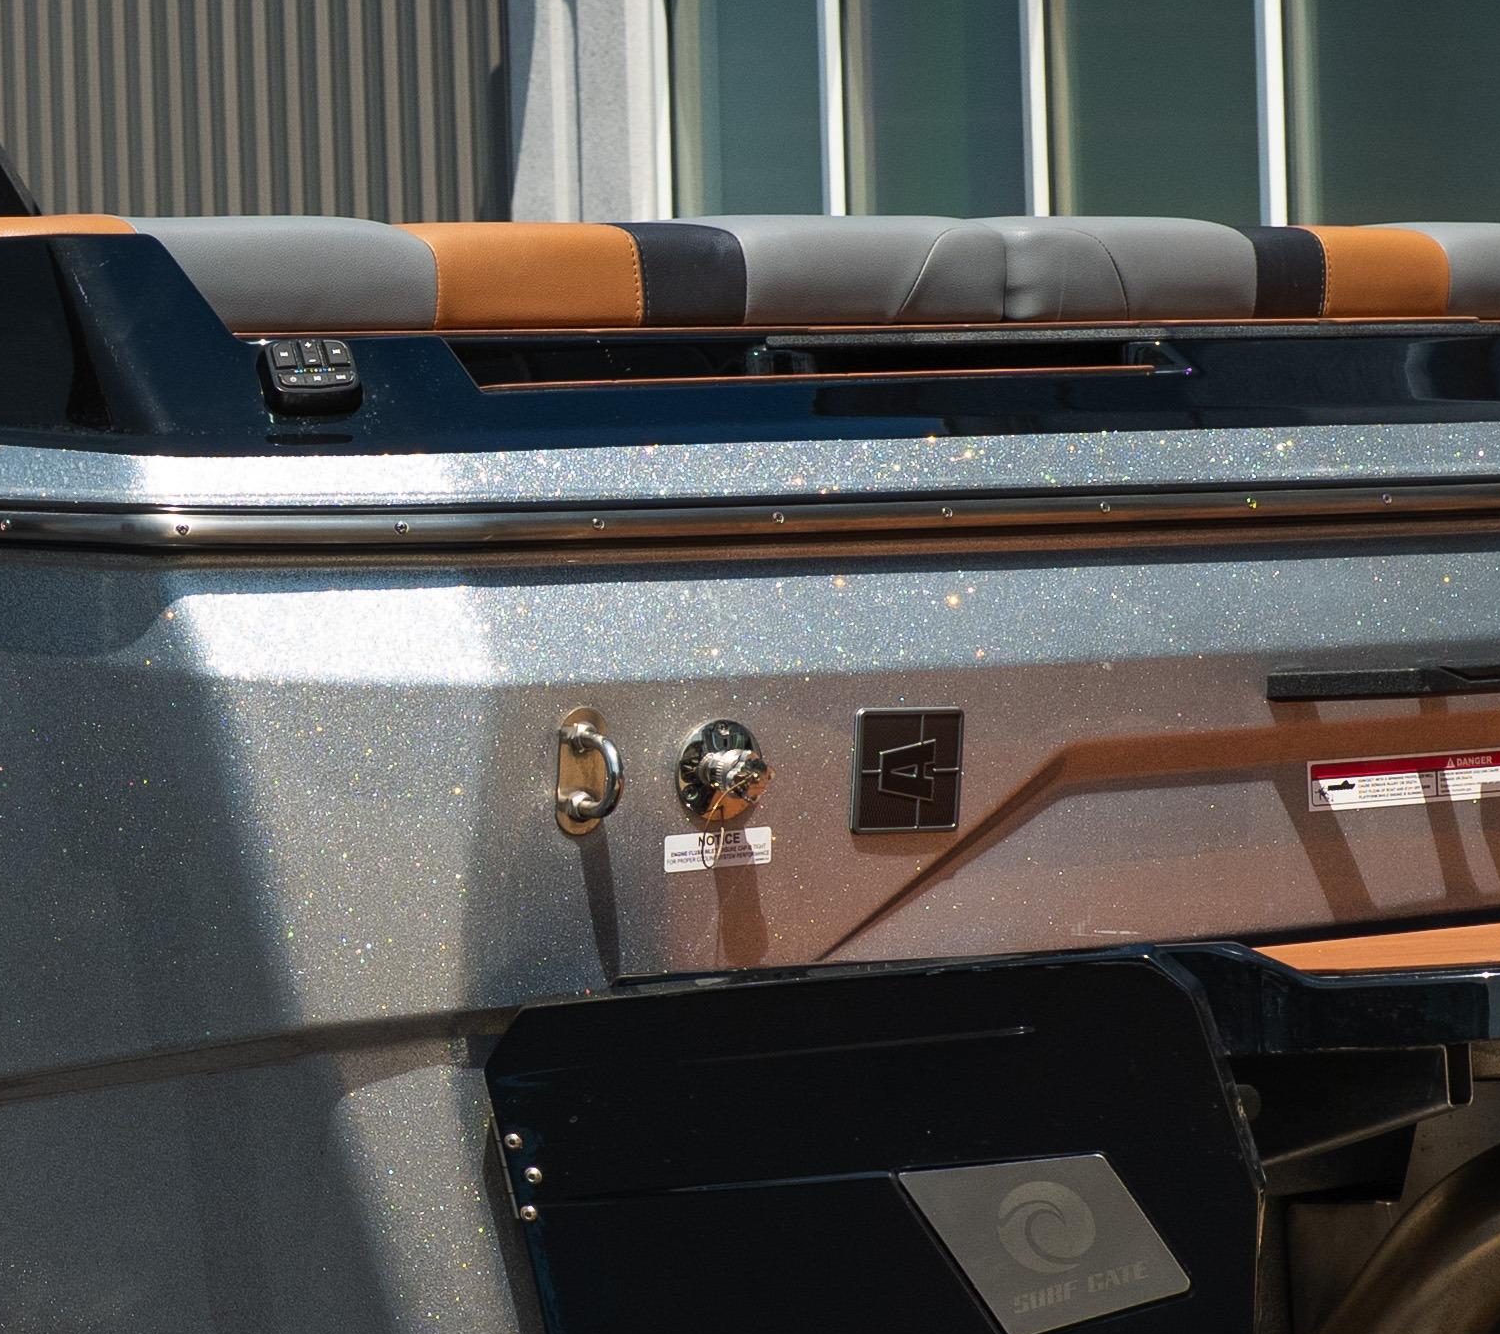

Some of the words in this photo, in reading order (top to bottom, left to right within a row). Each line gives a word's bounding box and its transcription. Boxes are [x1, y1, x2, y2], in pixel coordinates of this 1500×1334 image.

[1456, 755, 1493, 767] DANGER
[1013, 1279, 1079, 1315] SURF
[1087, 1261, 1150, 1293] GATE
